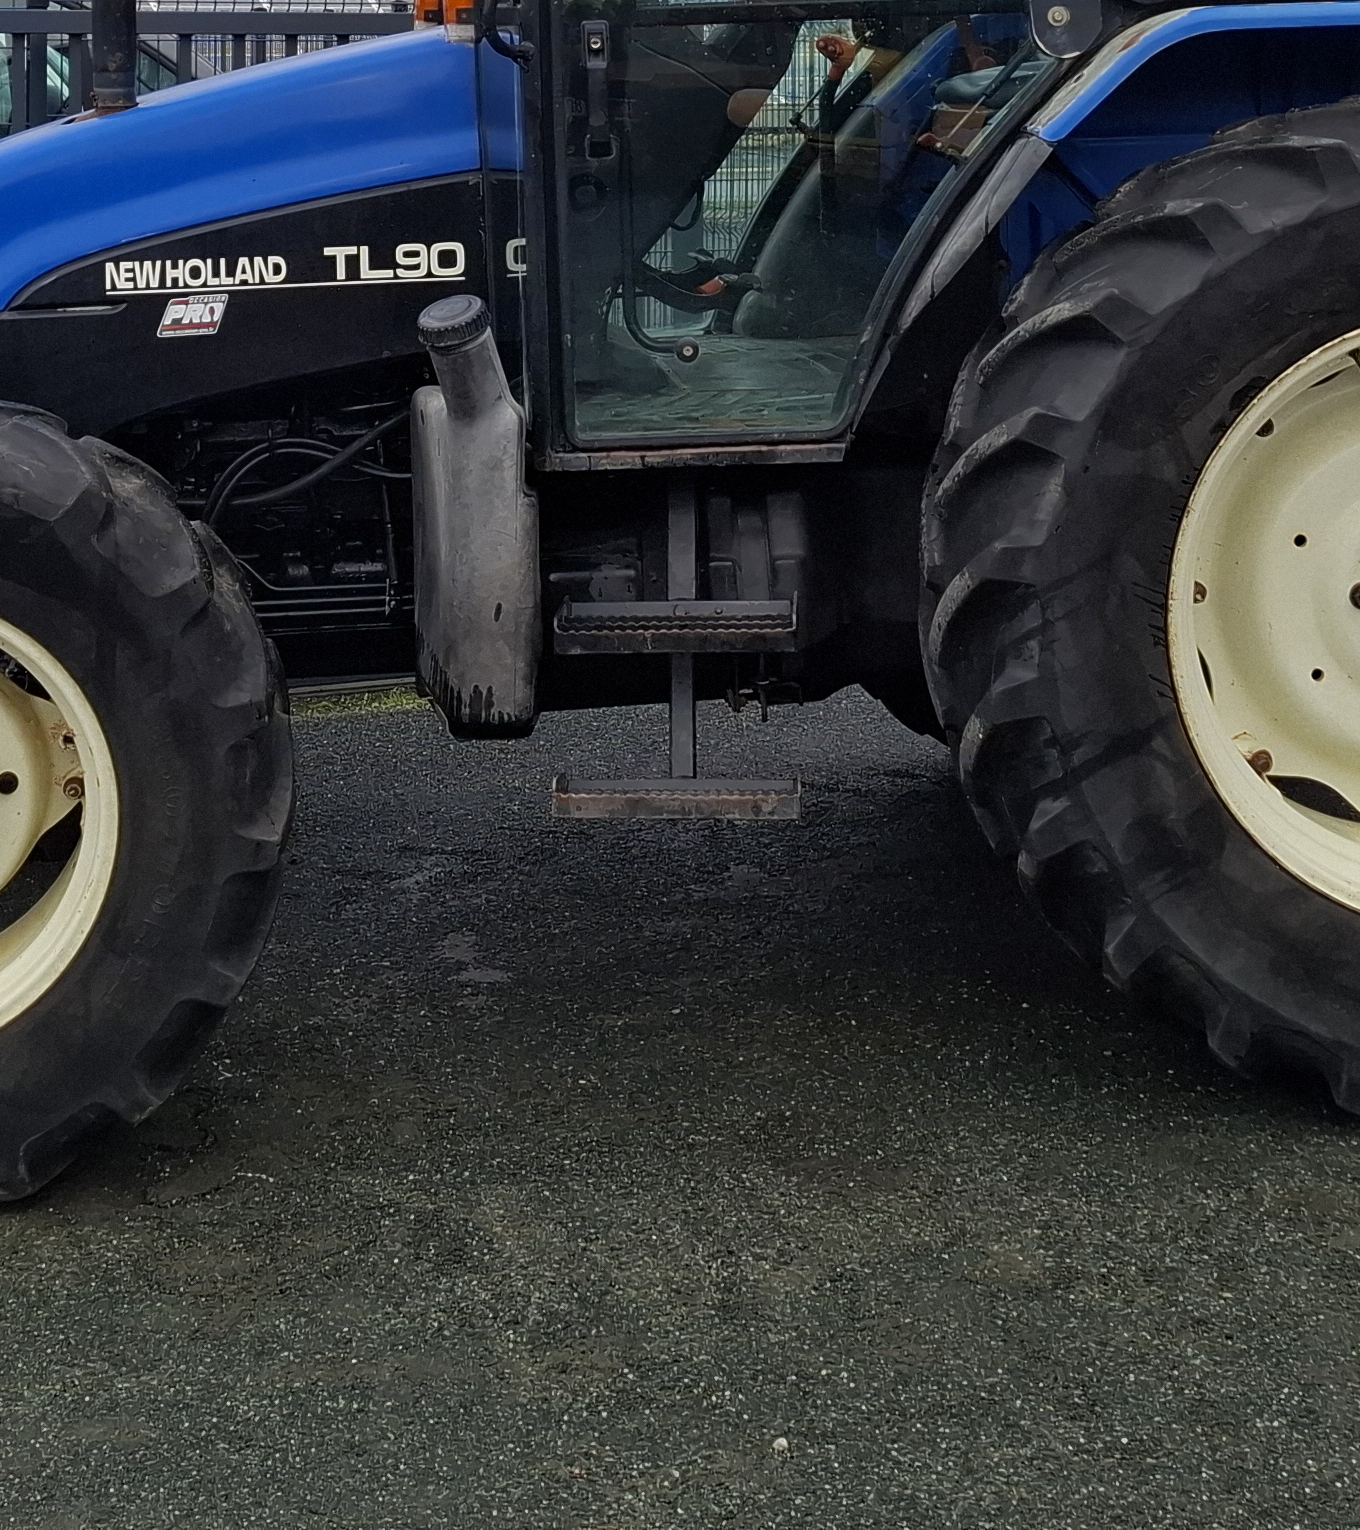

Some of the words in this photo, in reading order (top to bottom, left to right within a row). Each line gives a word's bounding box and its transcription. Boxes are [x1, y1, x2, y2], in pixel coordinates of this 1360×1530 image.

[105, 259, 162, 290] NEW
[165, 255, 288, 288] HOLLAND
[323, 241, 466, 281] TL90
[163, 302, 224, 325] PRO
